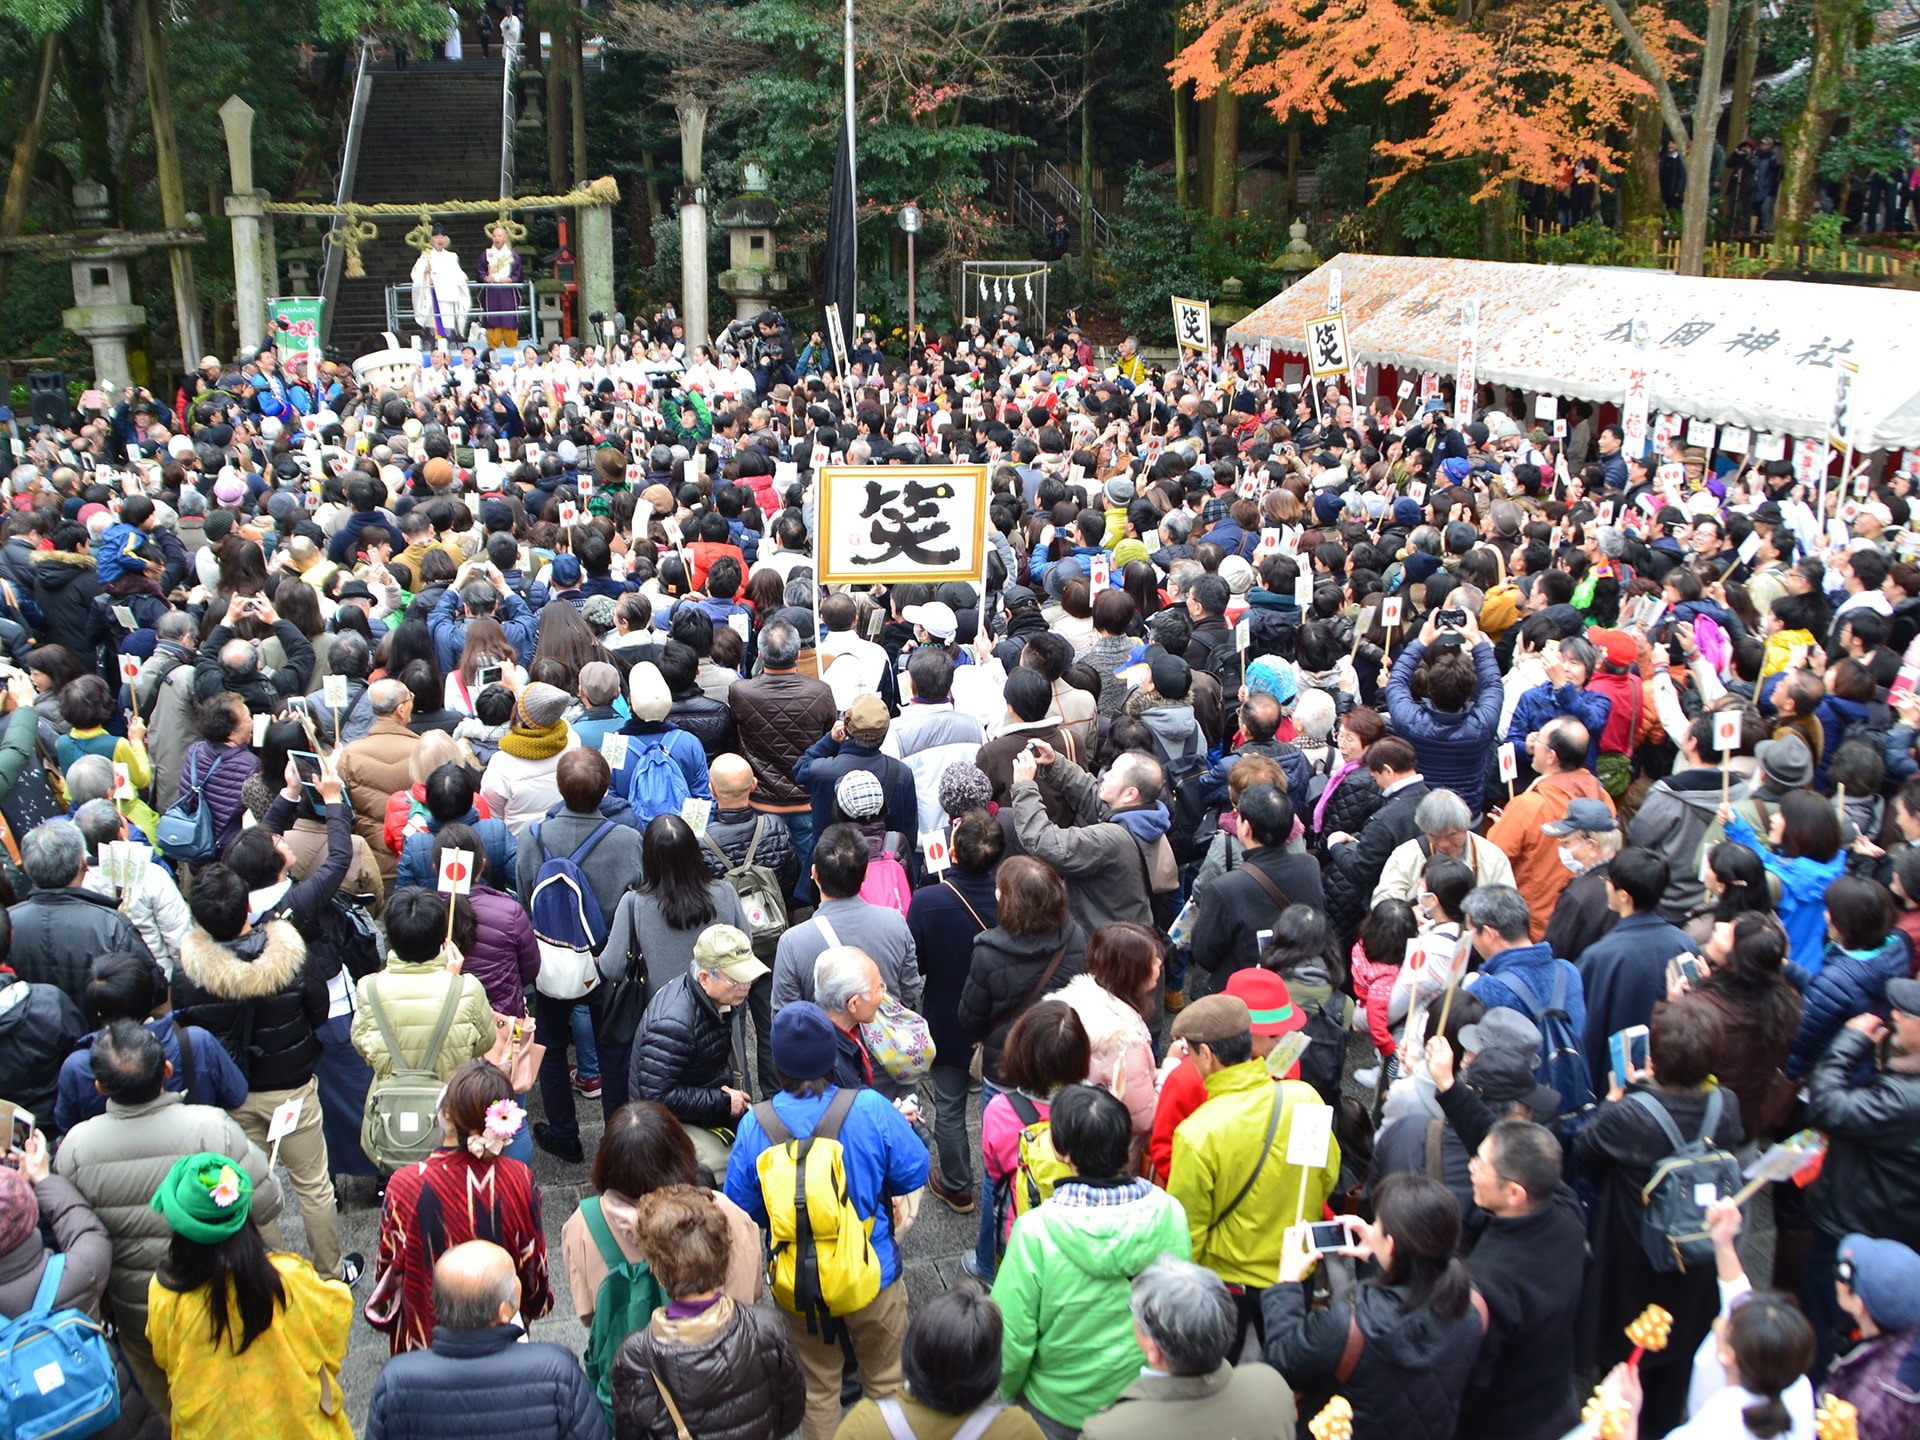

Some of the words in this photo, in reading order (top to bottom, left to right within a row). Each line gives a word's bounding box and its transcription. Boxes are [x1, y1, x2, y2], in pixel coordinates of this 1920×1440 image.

[277, 306, 317, 314] HANAZONO
[1182, 305, 1204, 343] 笑
[1315, 323, 1342, 367] 笑
[850, 480, 960, 565] 笑
